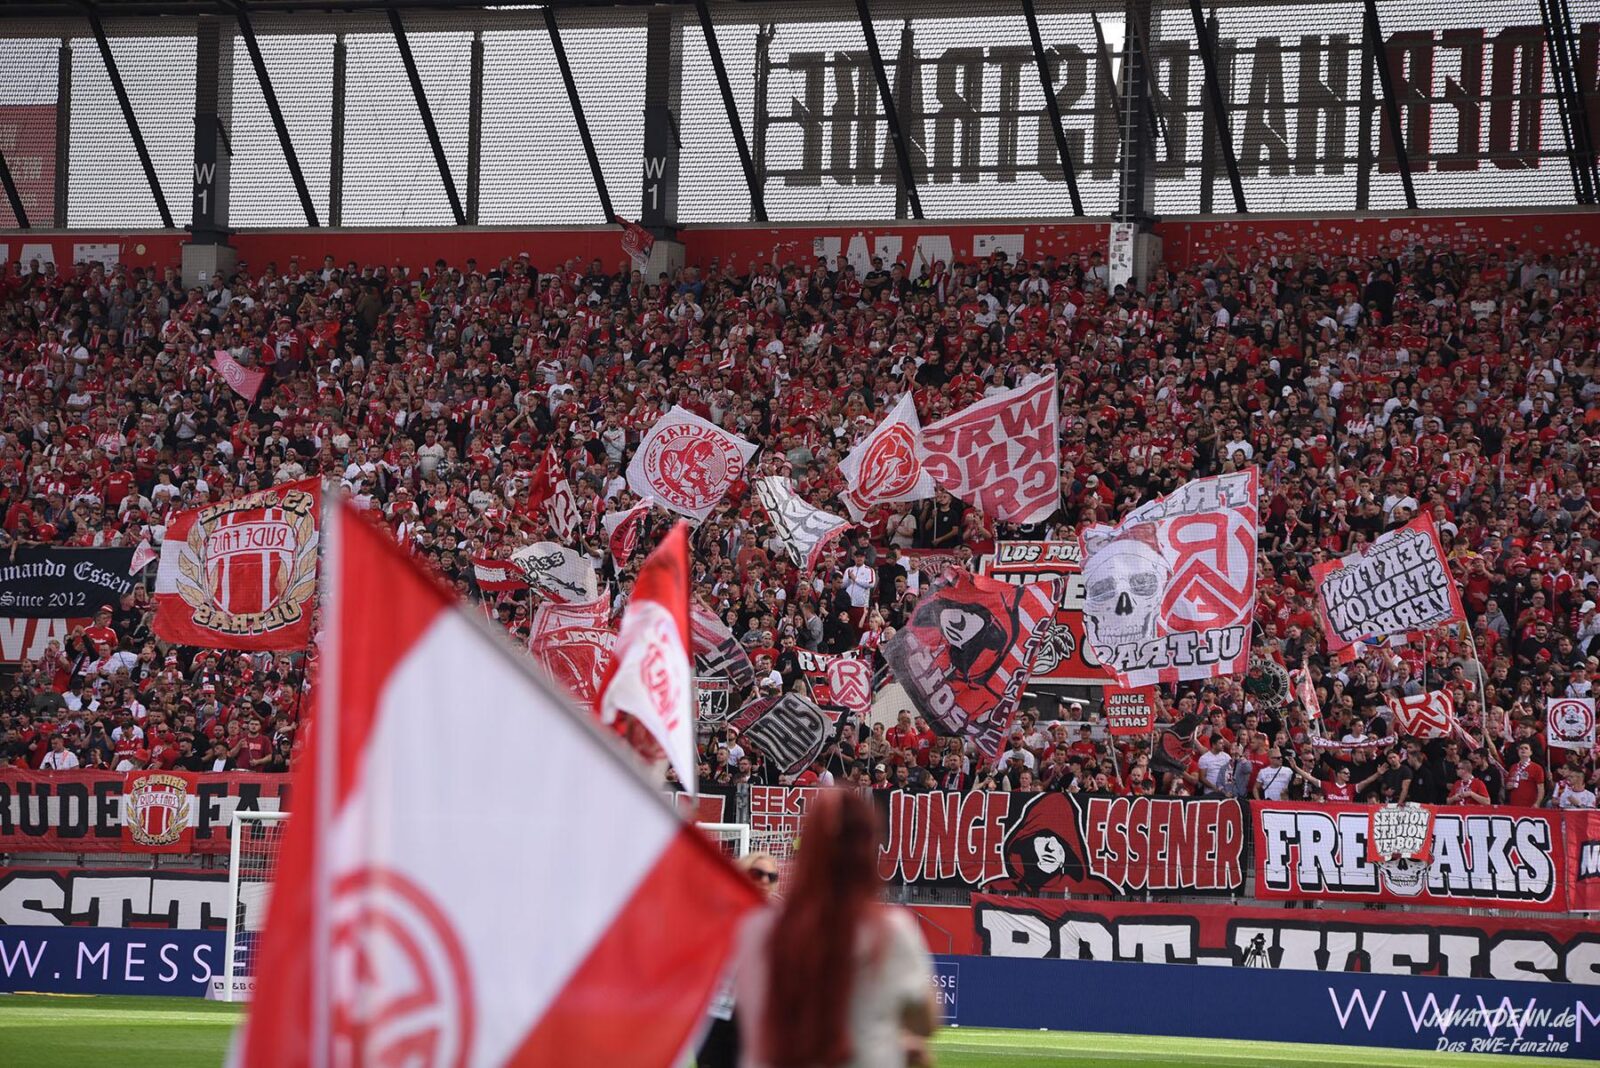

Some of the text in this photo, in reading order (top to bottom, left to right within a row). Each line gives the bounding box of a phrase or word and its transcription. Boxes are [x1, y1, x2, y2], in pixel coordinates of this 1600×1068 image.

[194, 163, 215, 215] W 1
[644, 157, 666, 211] W 1
[1001, 545, 1042, 563] LOS
[0, 559, 132, 595] mando Essen
[48, 592, 87, 607] 2012
[1110, 694, 1145, 705] JUNGE
[0, 780, 123, 838] RUDE
[1374, 811, 1430, 826] SEKTION
[877, 788, 1244, 891] JUNGE ESSENER
